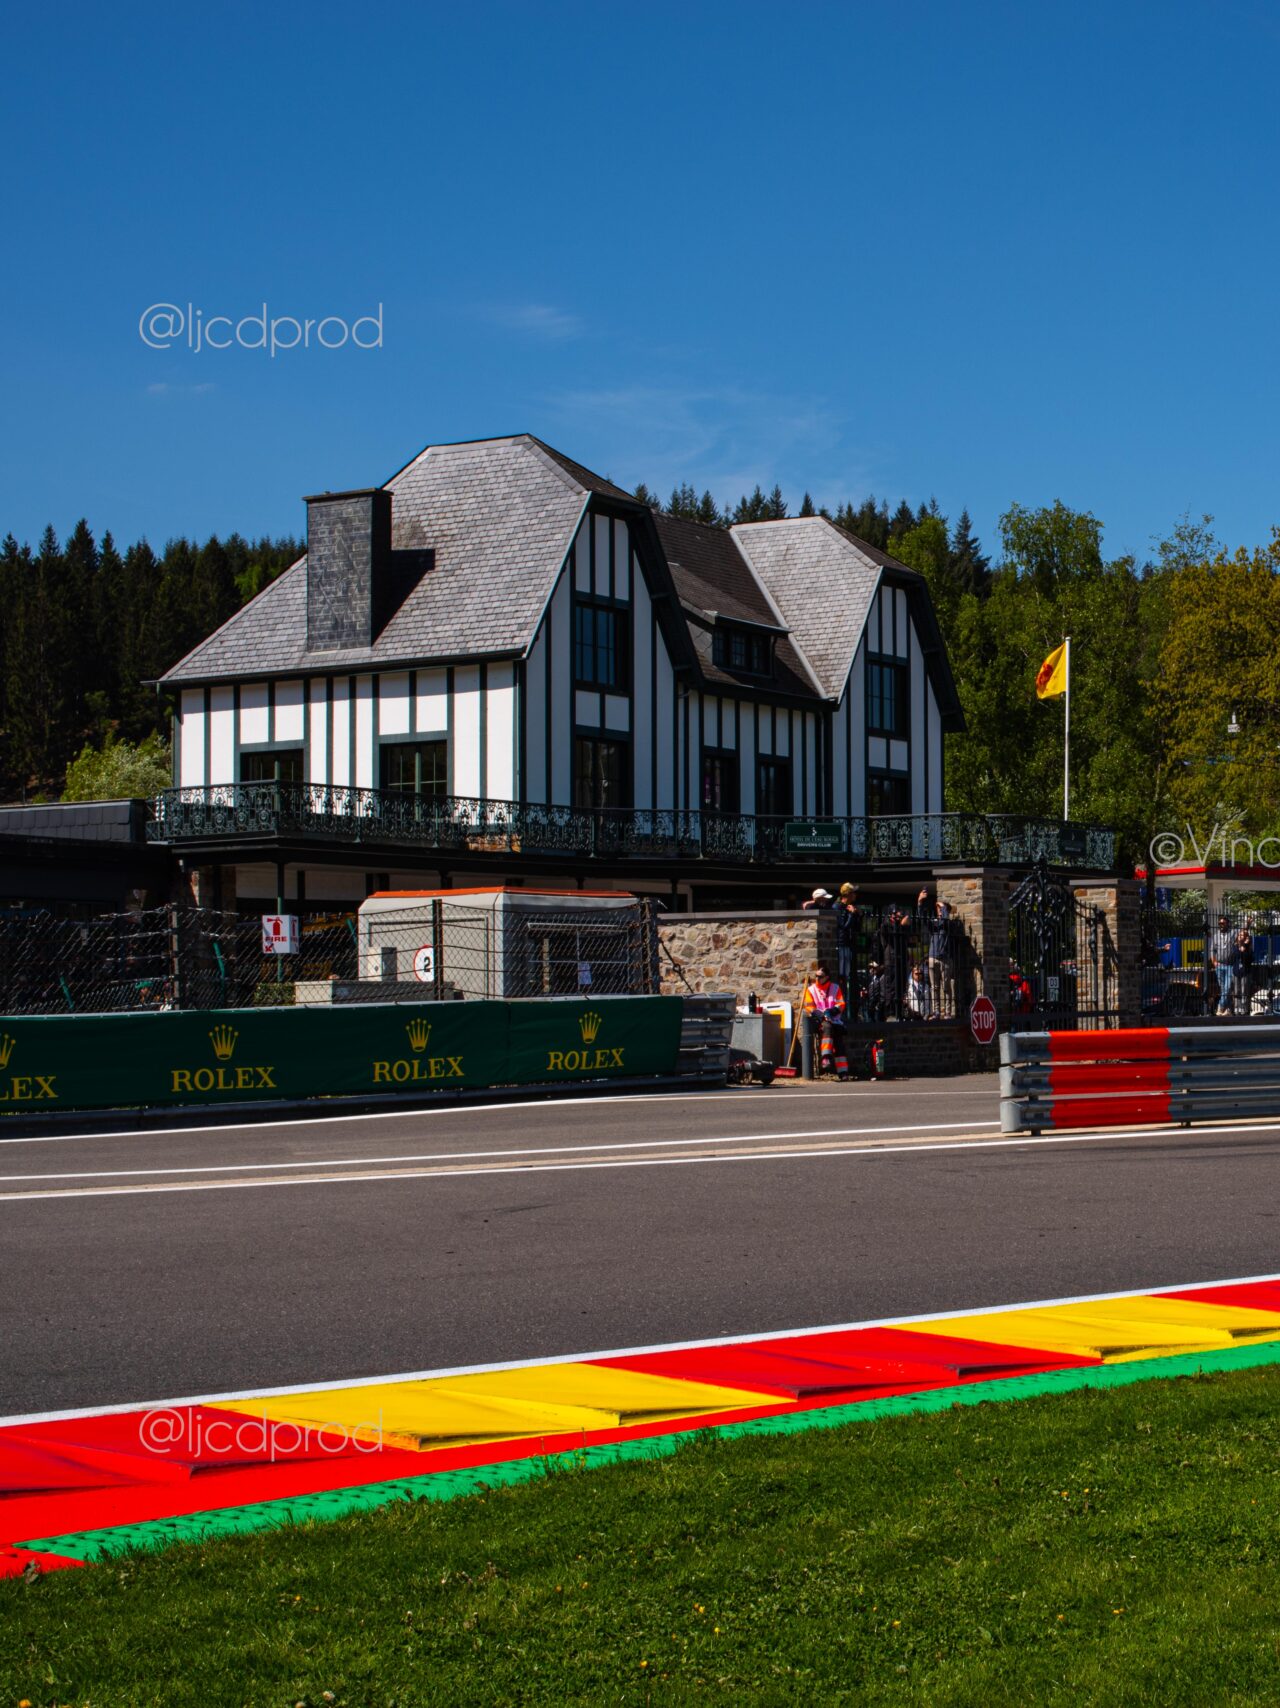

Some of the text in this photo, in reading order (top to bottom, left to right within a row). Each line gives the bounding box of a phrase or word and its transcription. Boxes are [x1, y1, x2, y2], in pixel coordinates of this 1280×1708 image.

[423, 955, 431, 972] 2
[972, 1011, 995, 1030] STOP
[372, 1056, 465, 1083] ROLEX
[546, 1047, 625, 1071] ROLEX
[170, 1066, 278, 1093] ROLEX
